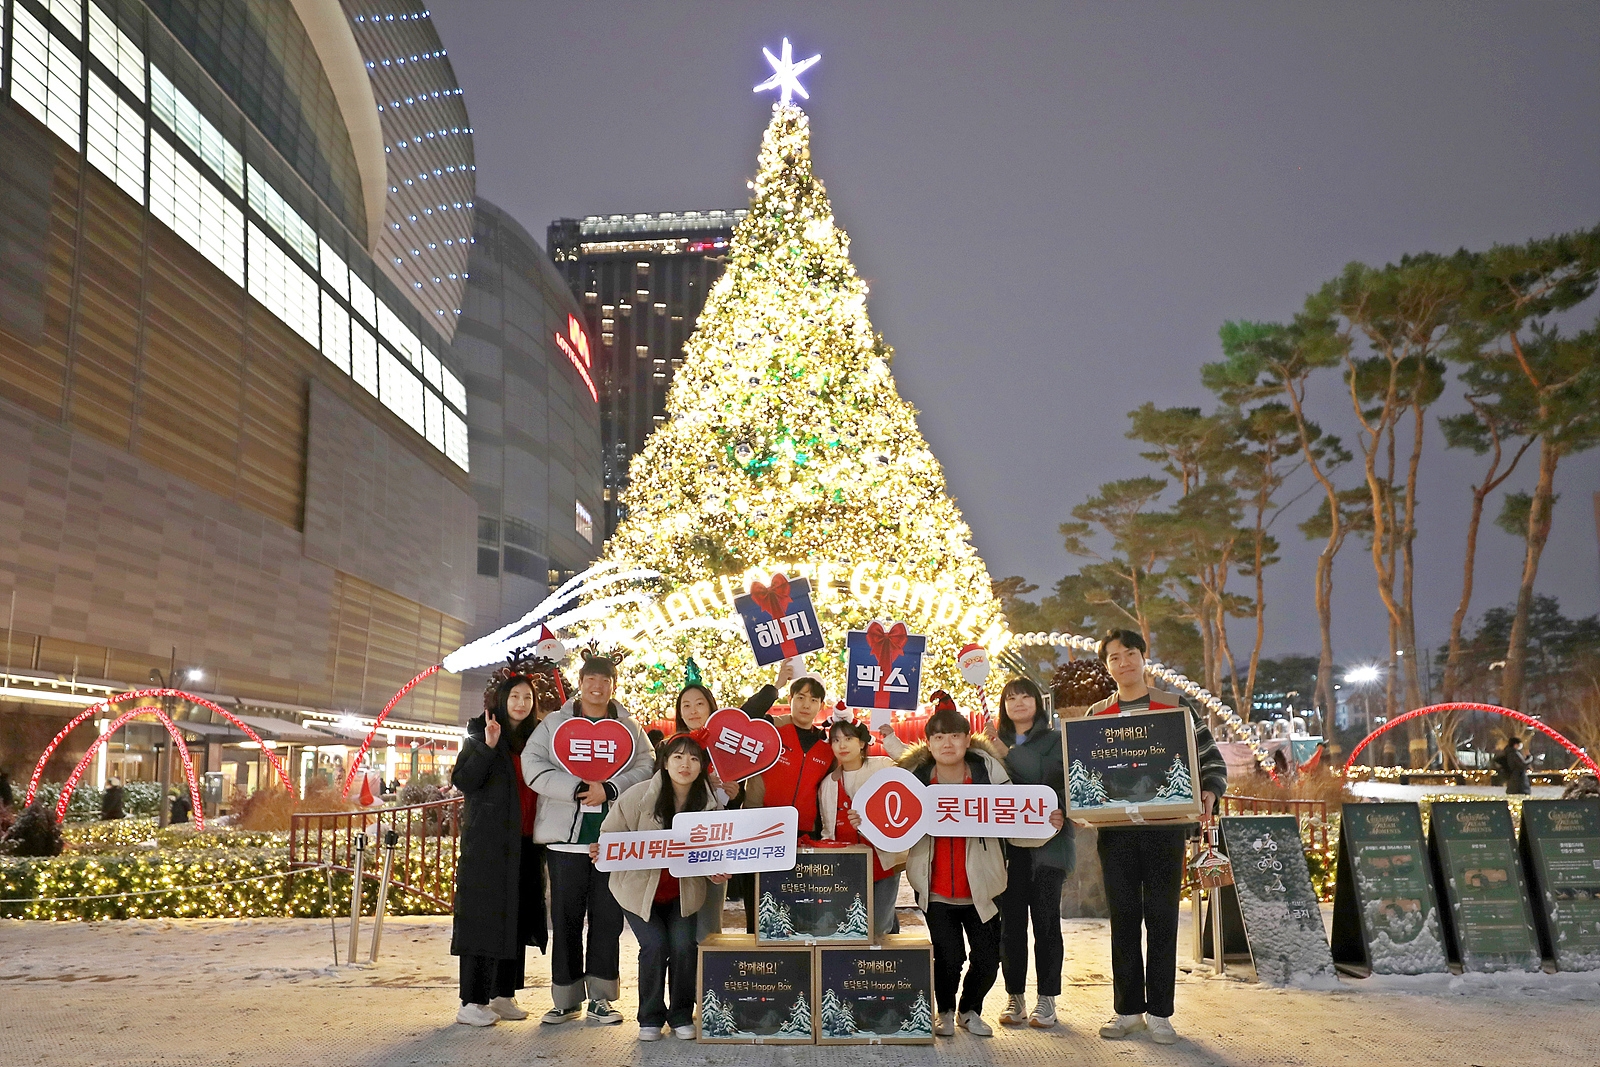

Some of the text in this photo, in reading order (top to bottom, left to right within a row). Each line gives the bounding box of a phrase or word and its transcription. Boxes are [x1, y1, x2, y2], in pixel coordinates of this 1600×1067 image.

[754, 610, 812, 648] 해피
[856, 665, 910, 693] 박스
[1104, 726, 1148, 743] 함께해요!
[568, 738, 617, 763] 토닥
[714, 726, 764, 764] 토닥
[1091, 745, 1166, 759] 토닥토닥 Happy Box
[936, 797, 1048, 824] 롯데물산
[690, 822, 733, 843] 송파!
[606, 840, 686, 861] 다시 뛰는
[687, 846, 786, 864] 창의와 혁신의 구정
[795, 863, 834, 878] 함께해요!
[781, 883, 849, 894] 토닥토닥 Happy Box
[1293, 909, 1310, 919] 금지
[738, 961, 777, 976] 함께해요!
[858, 960, 897, 975] 함께해요!
[724, 981, 792, 992] 토닥토닥 Happy Box
[843, 980, 912, 991] 토닥토닥 Happy Box
